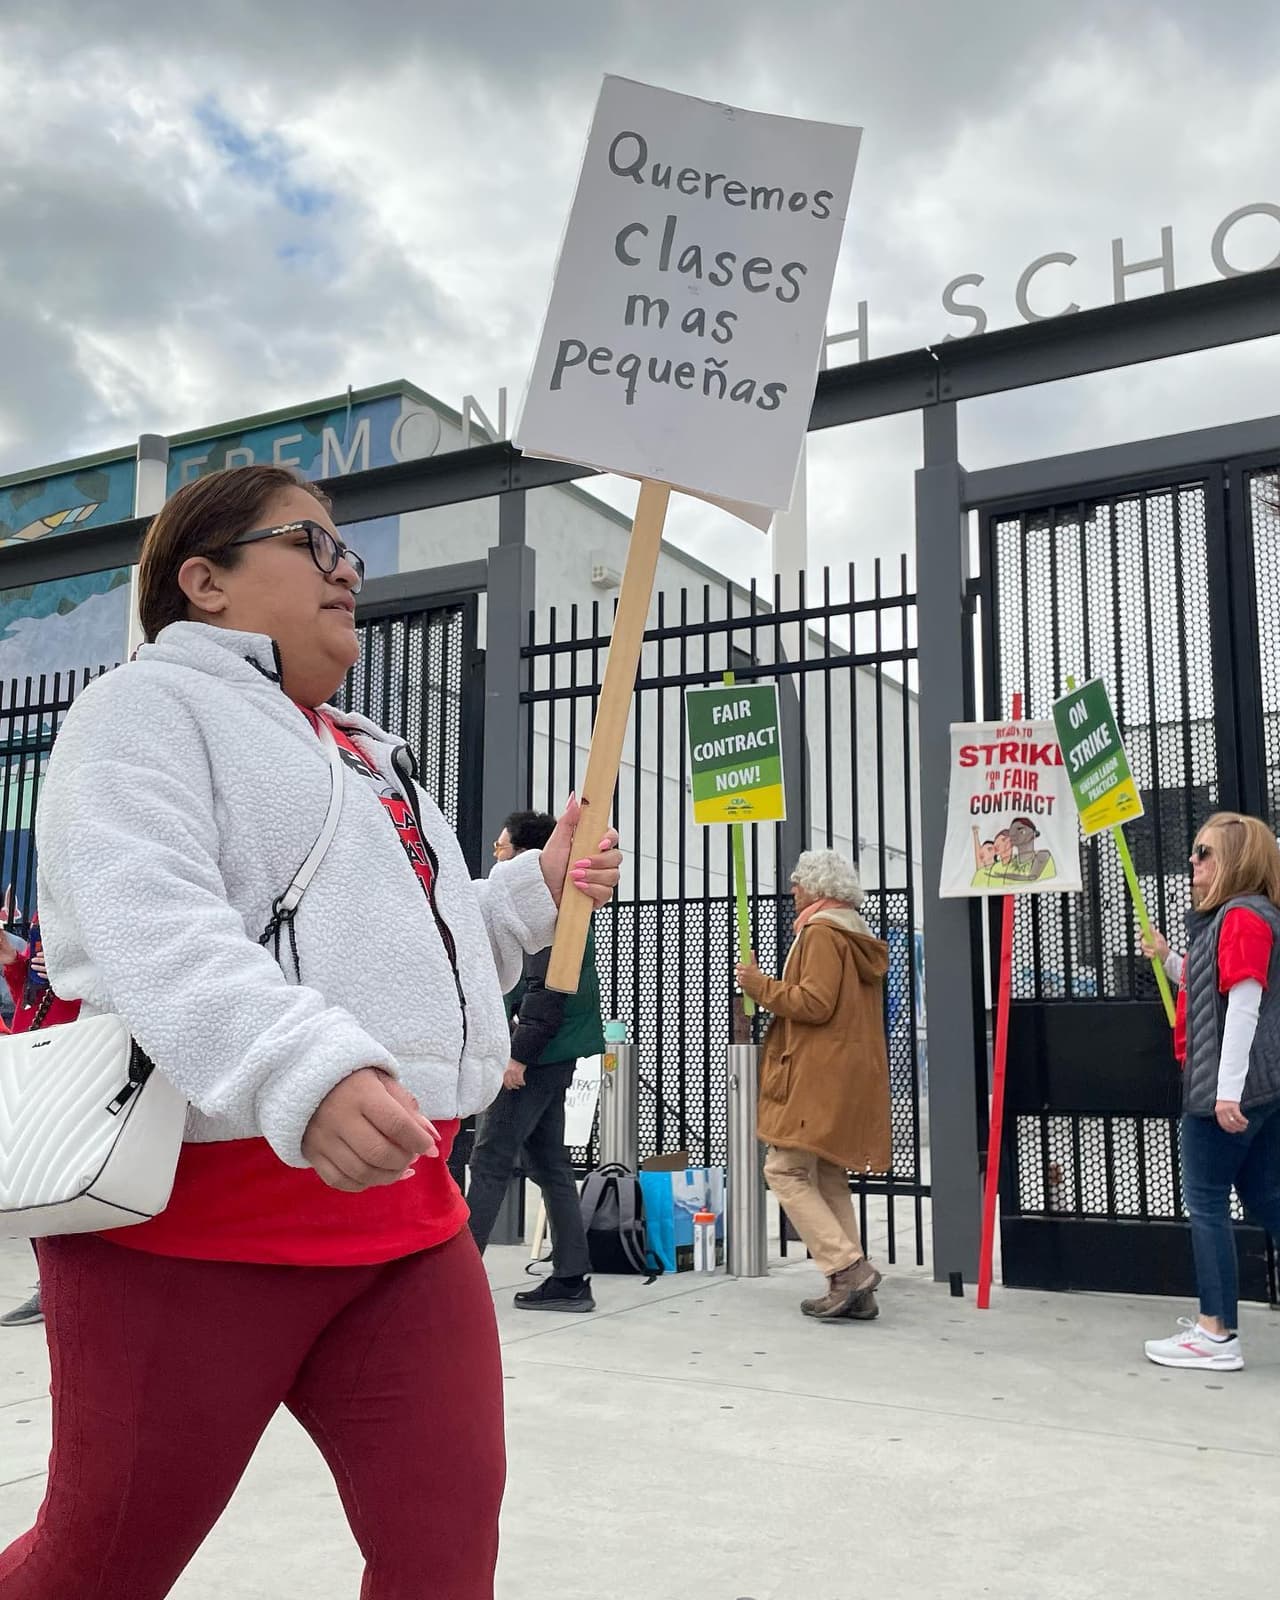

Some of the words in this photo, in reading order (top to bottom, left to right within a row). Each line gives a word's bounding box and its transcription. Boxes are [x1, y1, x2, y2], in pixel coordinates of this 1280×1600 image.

[608, 130, 834, 220] Queremos
[614, 215, 808, 303] clases
[941, 202, 1280, 342] SCHO
[624, 293, 738, 344] mas
[550, 339, 788, 411] pequeñas
[712, 699, 752, 726] FAIR
[1068, 698, 1089, 730] ON
[693, 726, 777, 762] CONTRACT
[1022, 727, 1033, 738] TO
[1069, 721, 1112, 773] STRIKE
[715, 765, 761, 792] NOW!
[986, 770, 1001, 781] FOR
[1003, 768, 1039, 792] FAIR
[970, 791, 1056, 816] CONTRACT
